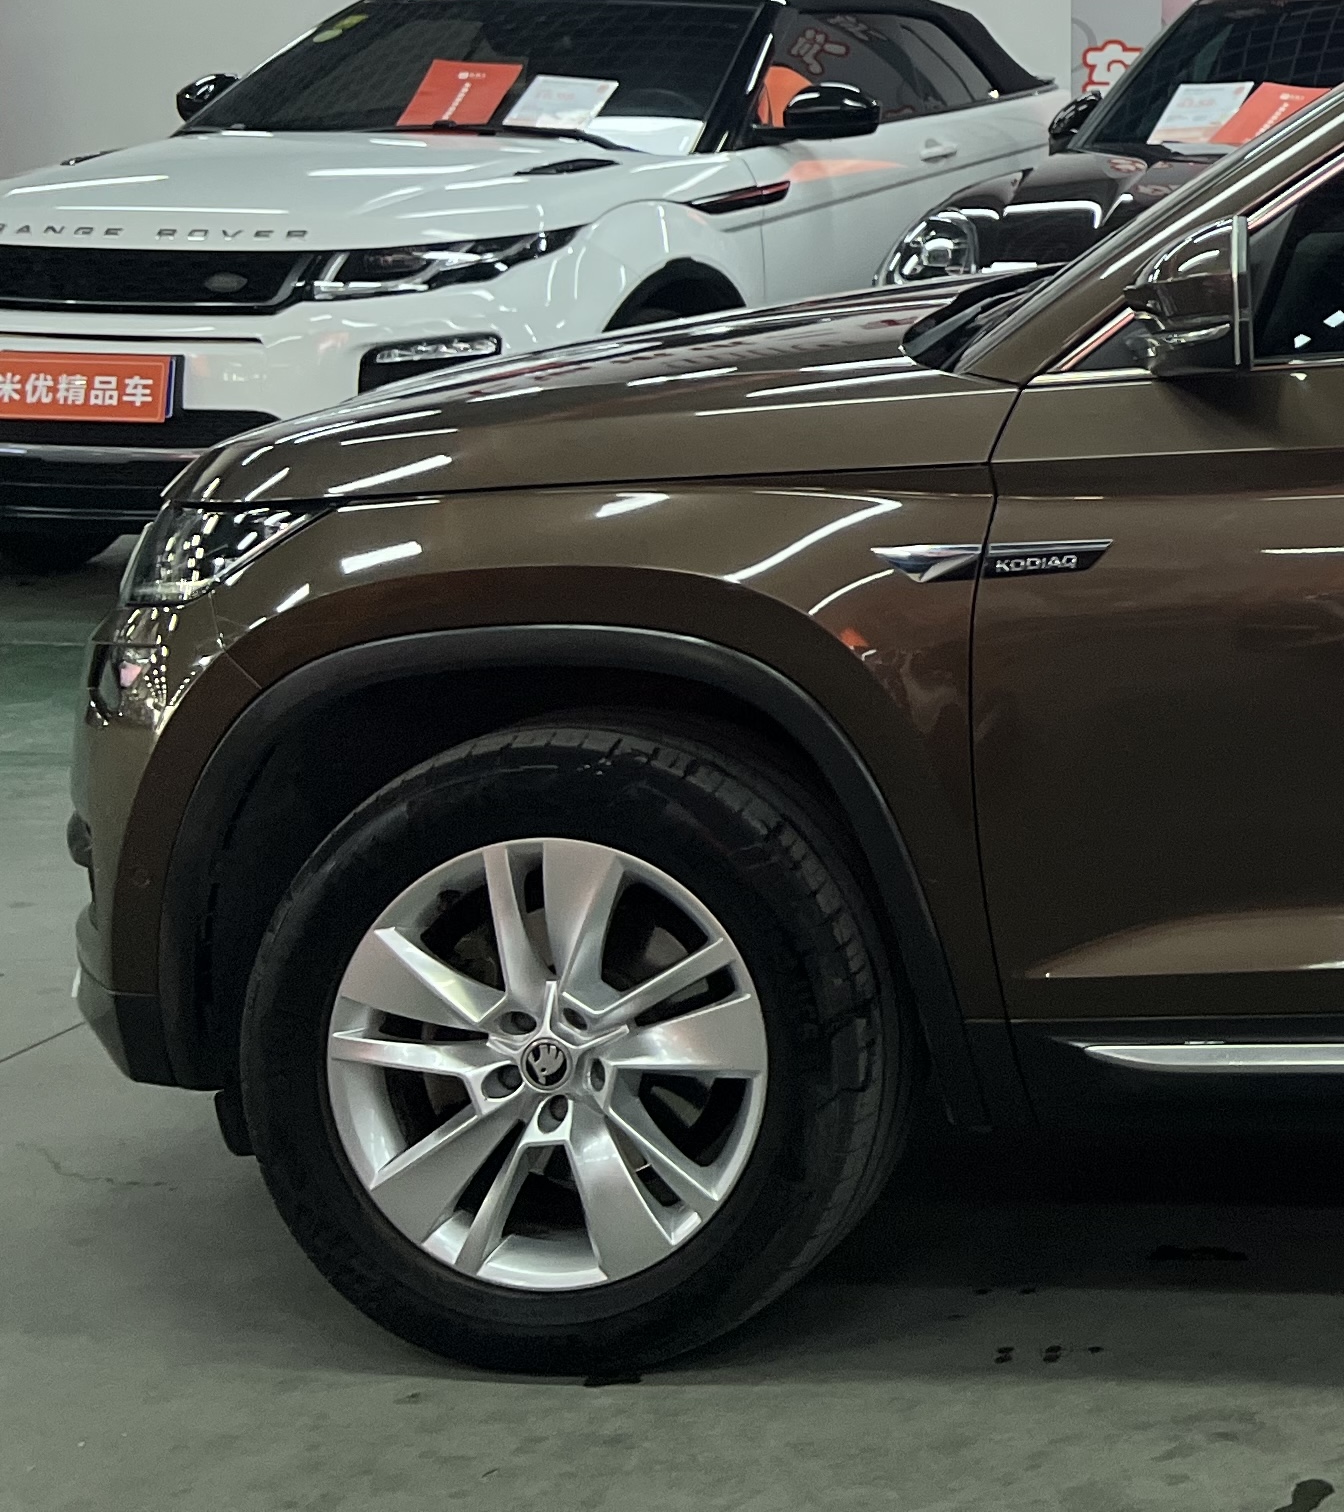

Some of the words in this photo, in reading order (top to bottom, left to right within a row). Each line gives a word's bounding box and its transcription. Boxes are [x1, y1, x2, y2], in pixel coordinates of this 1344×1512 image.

[0, 224, 125, 238] ANGE
[156, 227, 309, 240] ROVER
[0, 371, 154, 407] 米优精品车
[996, 554, 1079, 574] KODIAQ
